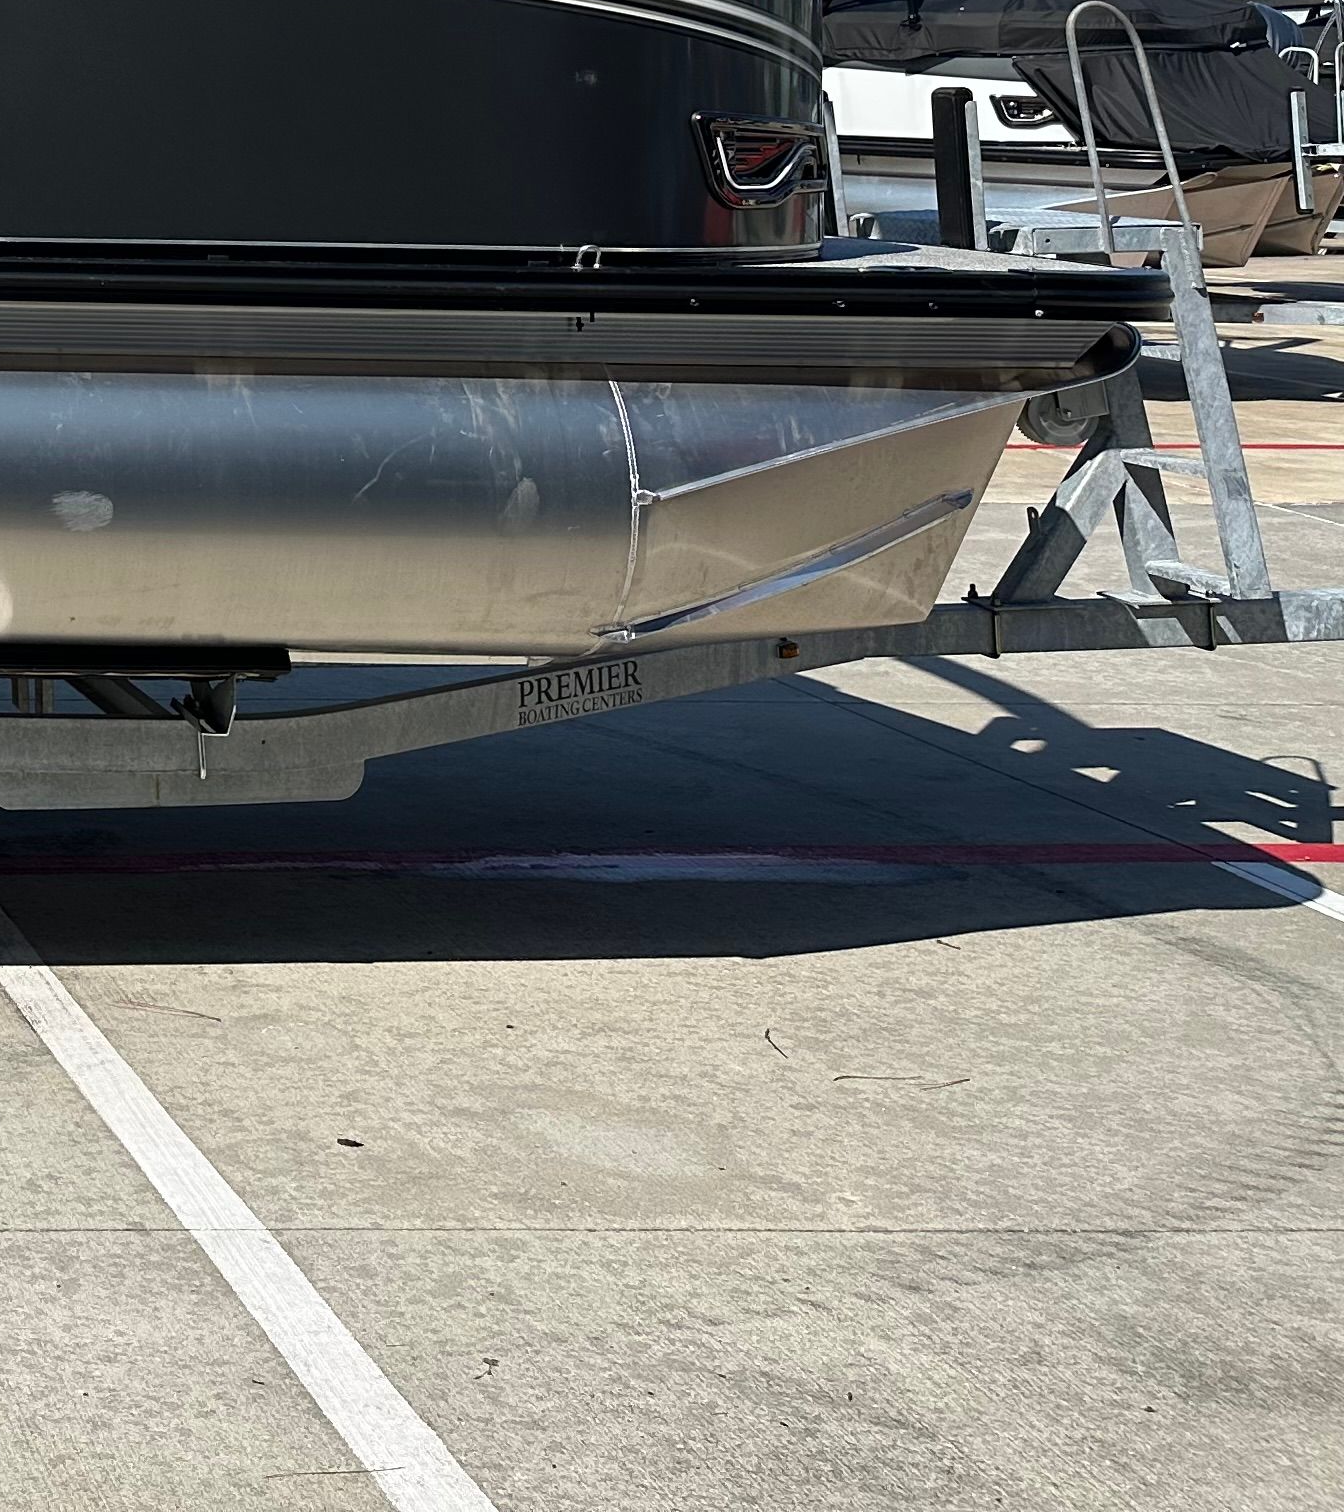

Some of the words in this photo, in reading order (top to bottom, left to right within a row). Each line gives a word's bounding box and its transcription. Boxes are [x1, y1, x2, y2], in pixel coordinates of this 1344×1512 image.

[518, 660, 642, 708] PREMIER
[518, 699, 580, 727] BOATING
[582, 688, 643, 713] CENTERS
